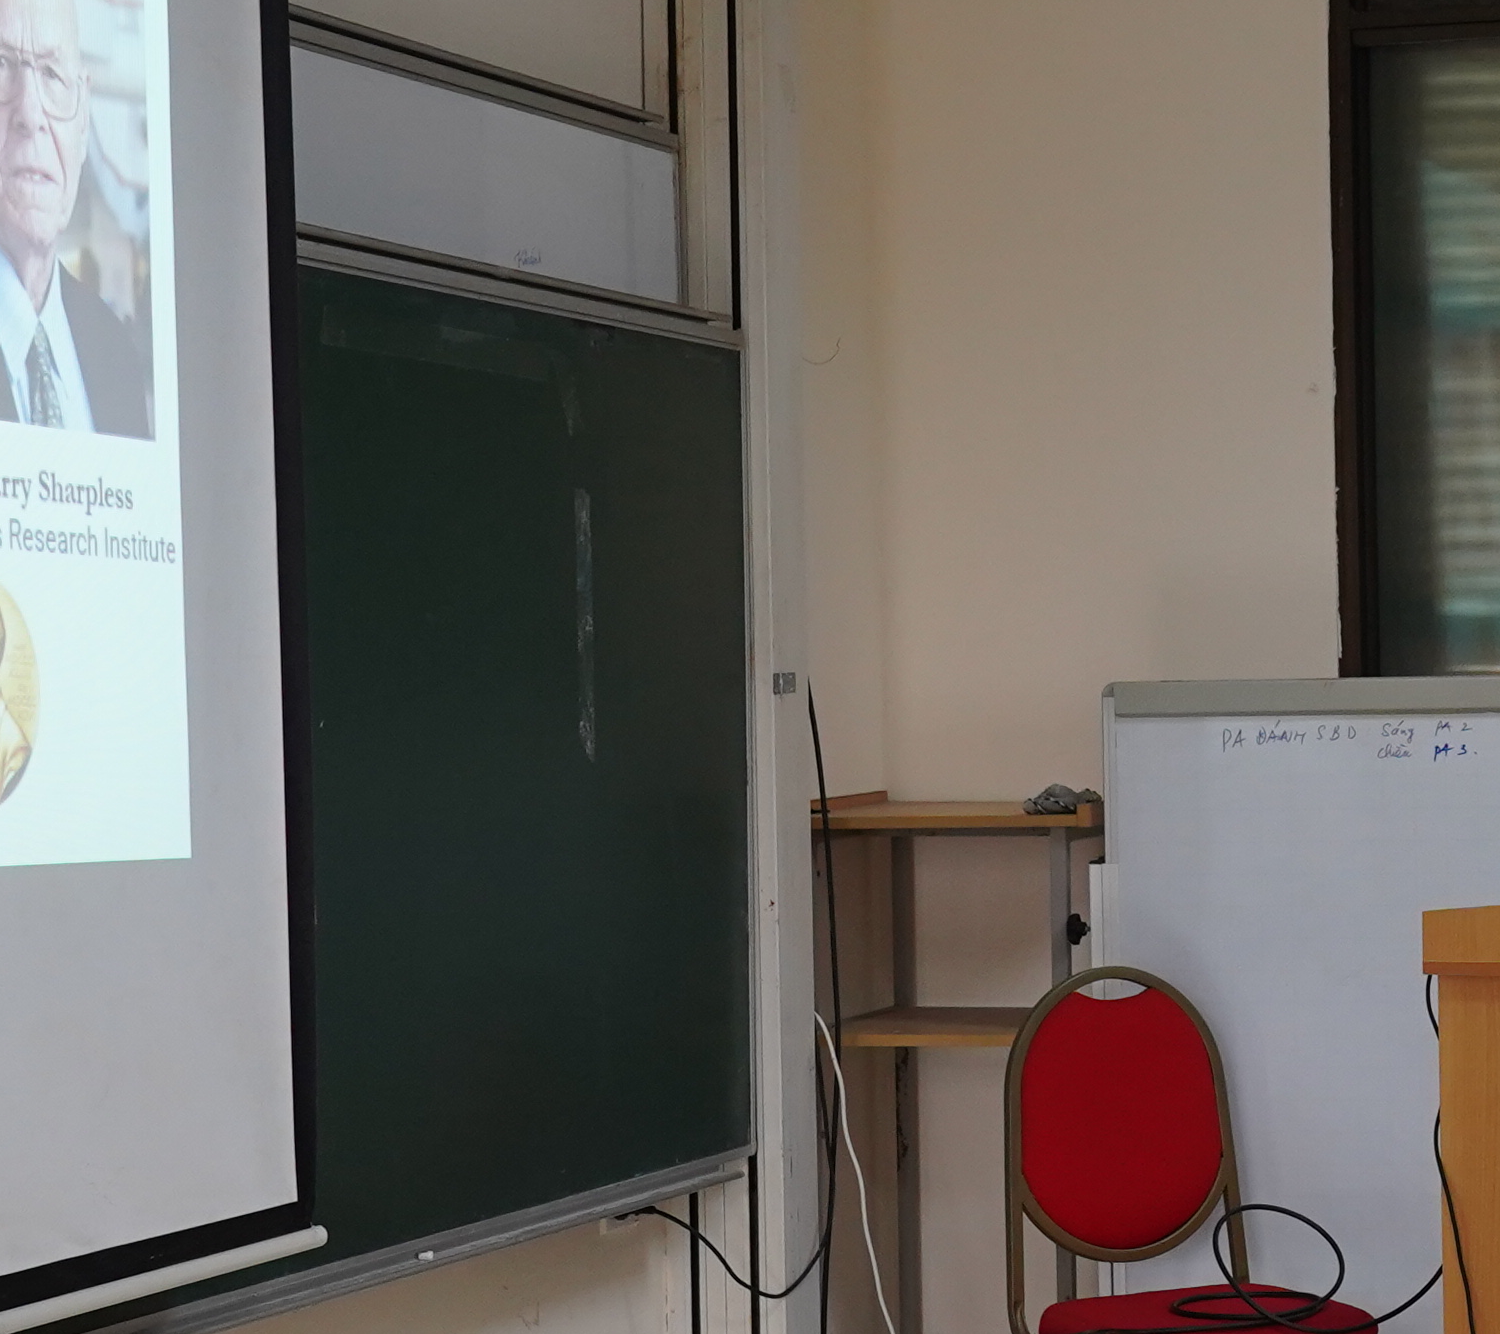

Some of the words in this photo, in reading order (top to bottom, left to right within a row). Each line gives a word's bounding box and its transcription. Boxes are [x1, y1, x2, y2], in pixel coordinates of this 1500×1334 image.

[38, 470, 134, 516] Sharpless
[9, 518, 98, 557] Research
[104, 527, 176, 564] Institute
